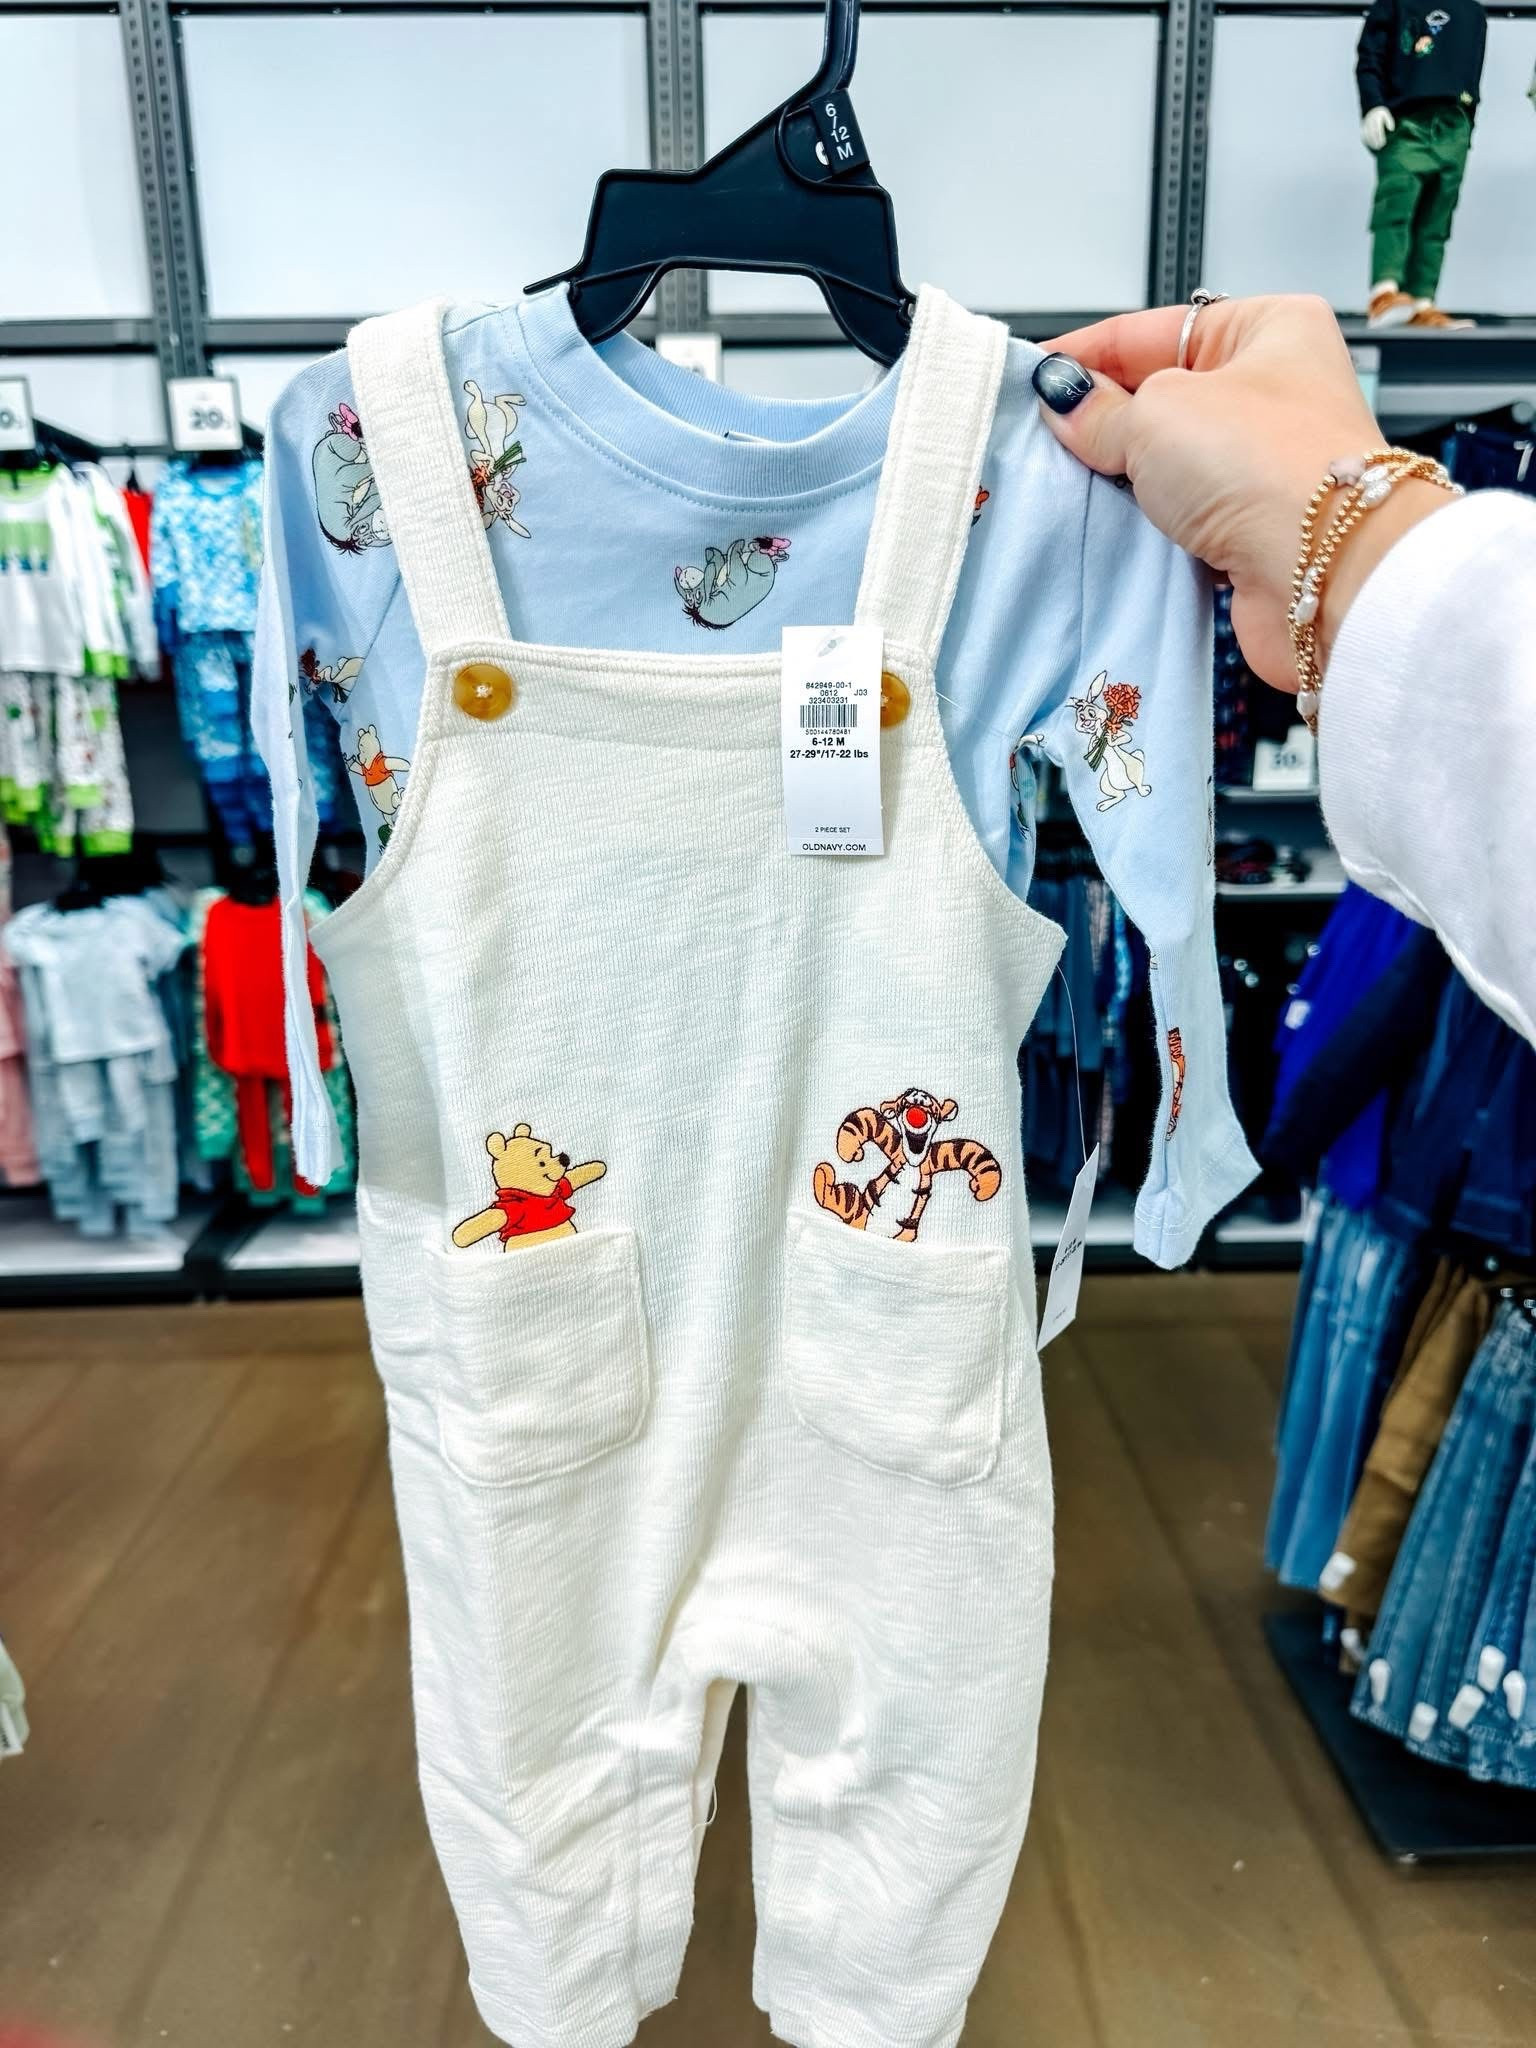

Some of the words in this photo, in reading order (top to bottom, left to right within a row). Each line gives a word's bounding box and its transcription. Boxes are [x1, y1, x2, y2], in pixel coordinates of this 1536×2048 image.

[825, 103, 837, 117] 6
[830, 126, 850, 143] 12
[836, 142, 854, 160] M
[820, 689, 838, 697] 0612
[854, 688, 868, 696] J03
[809, 696, 848, 704] 323403231
[812, 737, 833, 746] 6-12
[836, 737, 845, 746] M
[790, 749, 851, 758] 27-29"/17-22
[854, 749, 869, 758] lbs
[802, 843, 866, 851] OLDNAVY.COM
